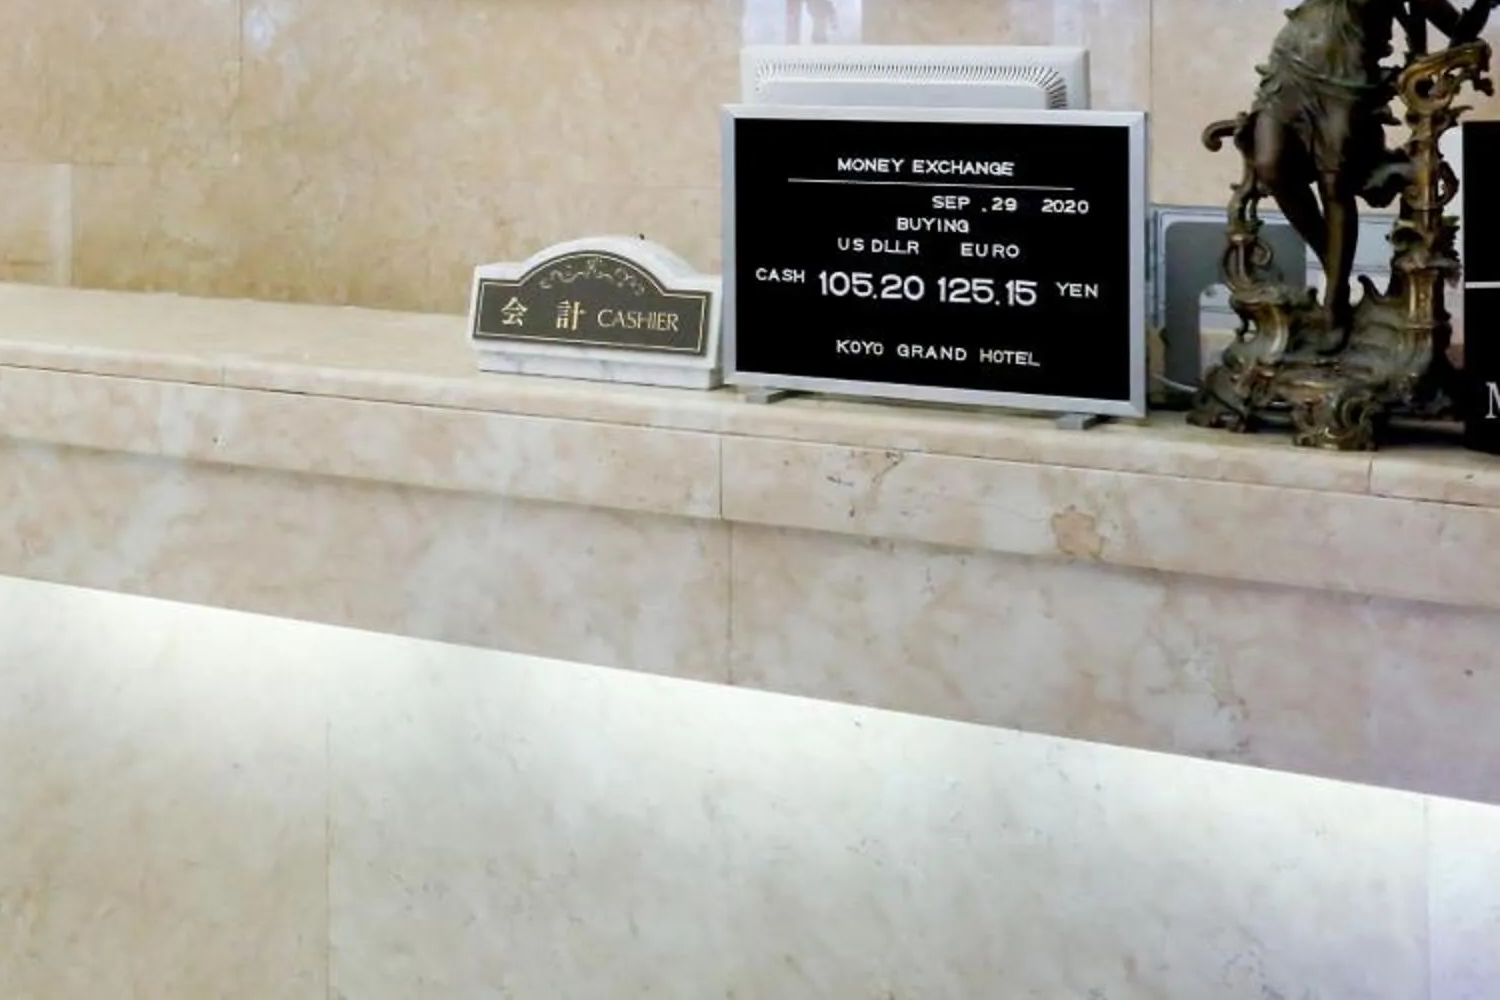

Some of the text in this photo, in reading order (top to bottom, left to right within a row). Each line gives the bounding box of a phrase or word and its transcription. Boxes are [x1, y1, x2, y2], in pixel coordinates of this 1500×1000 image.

[837, 157, 1015, 177] MONEY EXCHANGE
[932, 195, 971, 211] SEP
[1041, 198, 1090, 215] 2020
[896, 216, 970, 234] BUYING
[837, 237, 1021, 259] US DLLR EURO
[755, 266, 1099, 307] CASH 105.20 125.15 YEN
[597, 307, 679, 332] CASHIER
[835, 339, 1041, 368] KOYO GRAND HOTEL
